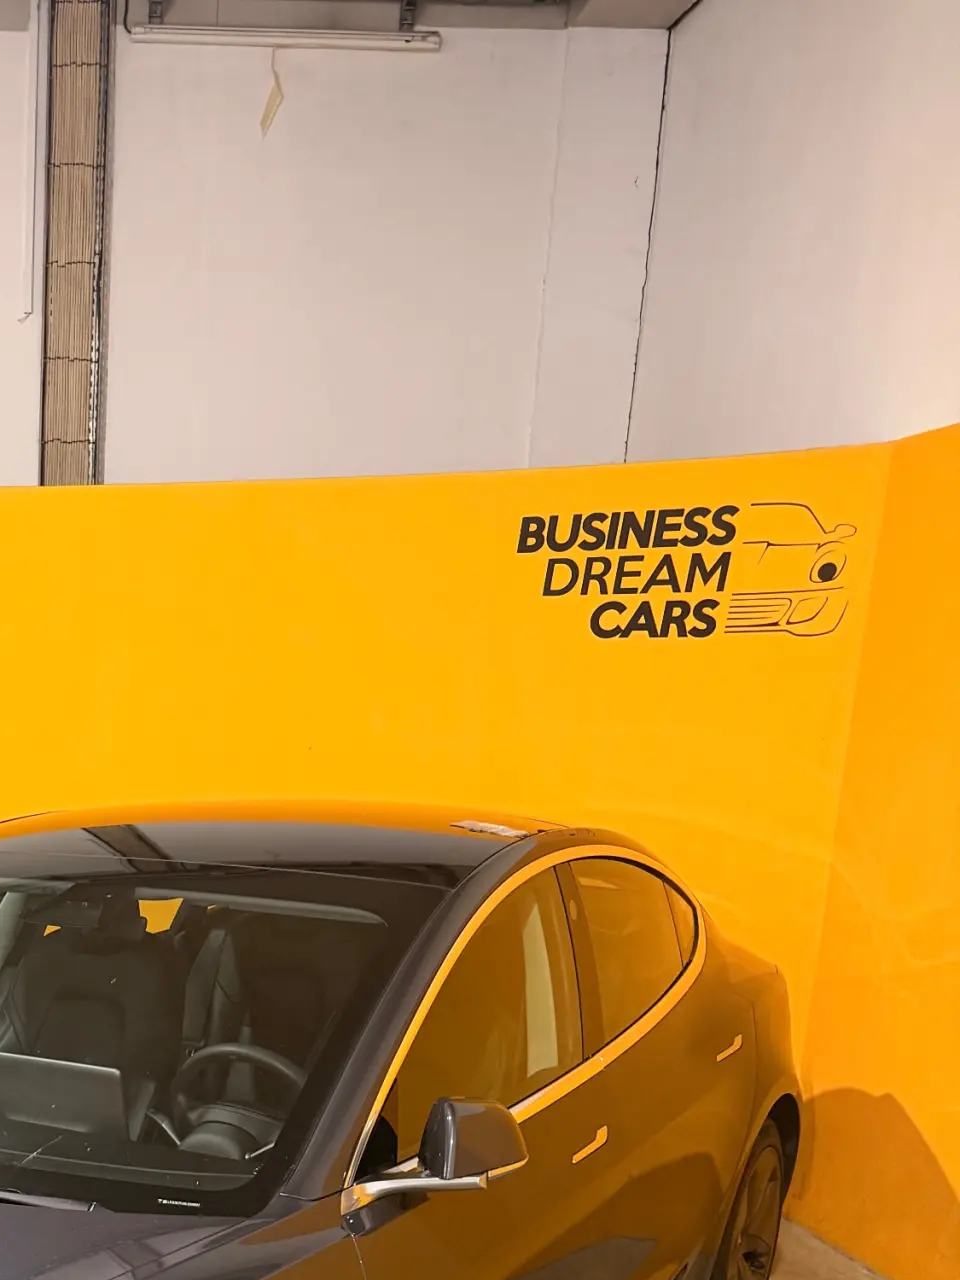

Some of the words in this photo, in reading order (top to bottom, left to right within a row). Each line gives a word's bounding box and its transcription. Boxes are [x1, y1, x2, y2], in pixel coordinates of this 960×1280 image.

[517, 505, 740, 553] BUSINESS
[542, 551, 732, 596] DREAM
[590, 599, 720, 639] CARS
